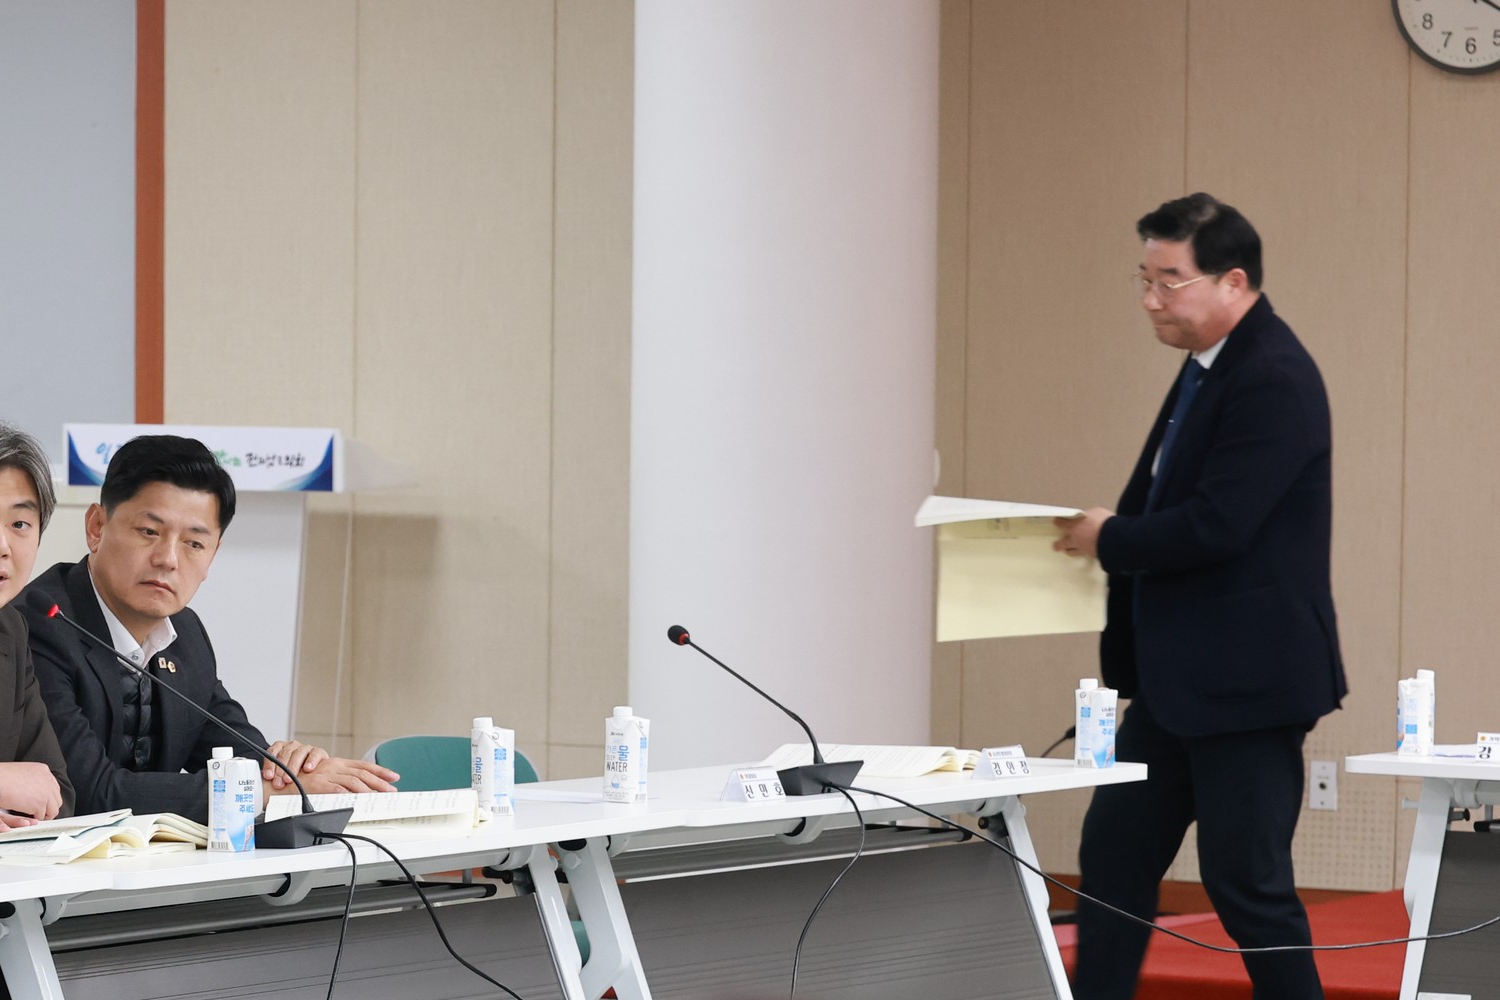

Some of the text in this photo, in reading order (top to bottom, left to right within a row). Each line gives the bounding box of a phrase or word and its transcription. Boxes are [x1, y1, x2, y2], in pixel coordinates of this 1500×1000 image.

[1422, 13, 1433, 30] 8
[1441, 31, 1453, 48] 7
[1465, 37, 1477, 54] 6
[606, 761, 628, 772] WATER
